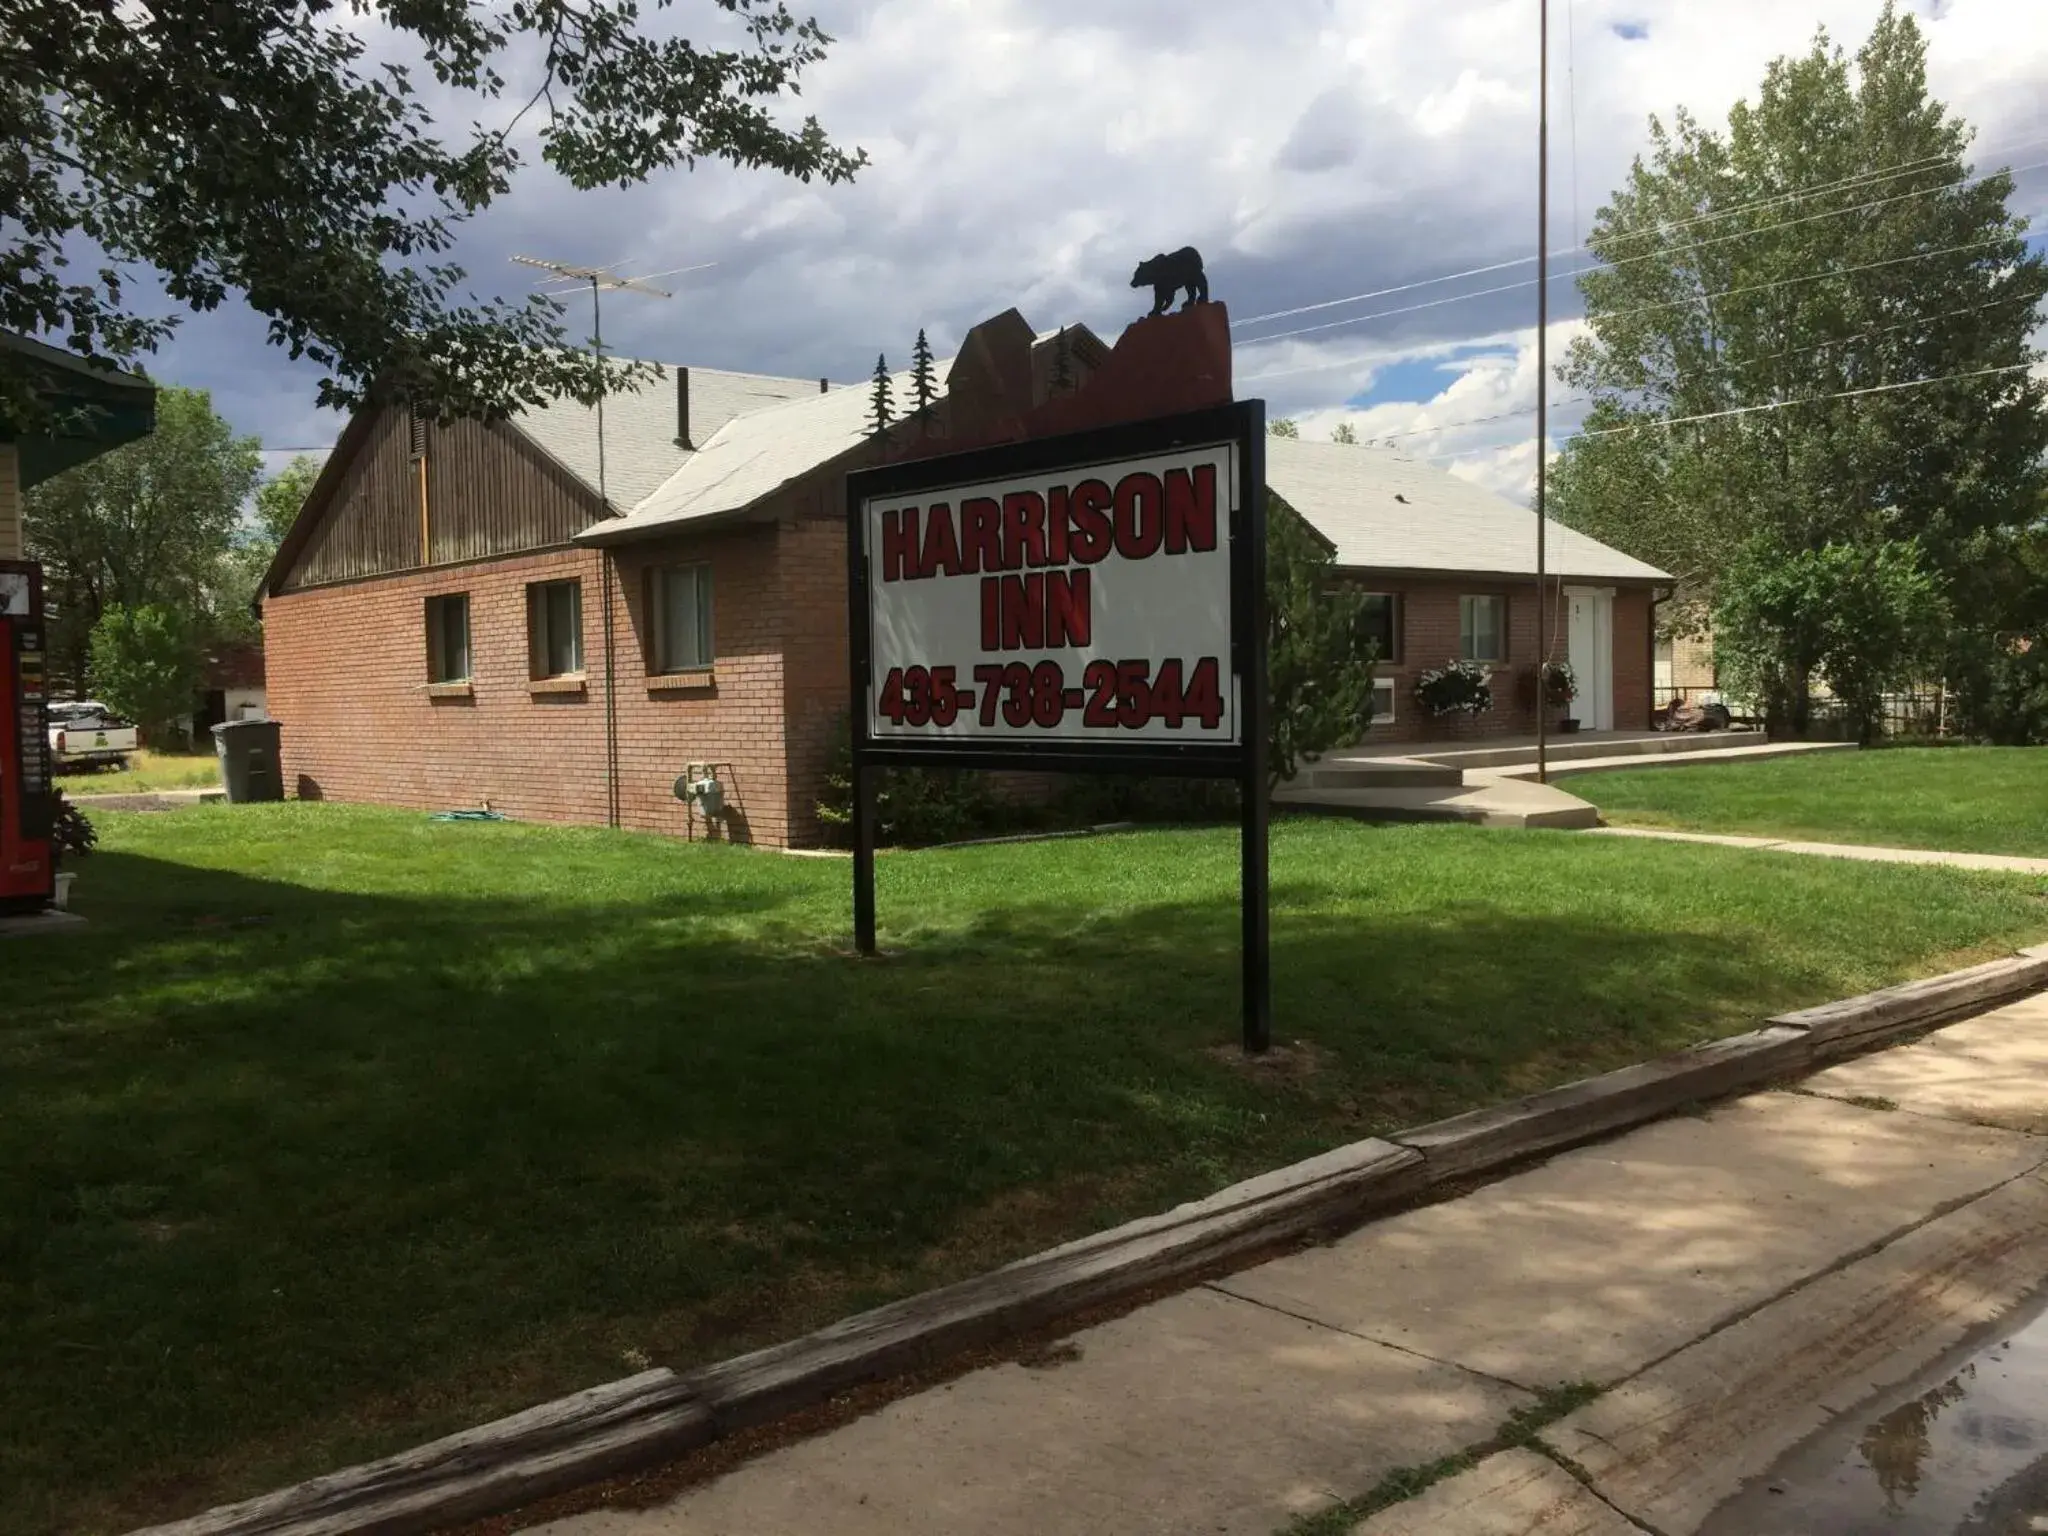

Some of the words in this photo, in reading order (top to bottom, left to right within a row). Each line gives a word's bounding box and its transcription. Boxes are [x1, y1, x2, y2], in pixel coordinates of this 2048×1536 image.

[883, 463, 1217, 582] HARRISON
[981, 568, 1091, 651] INN
[879, 657, 1224, 729] 435-738-2544
